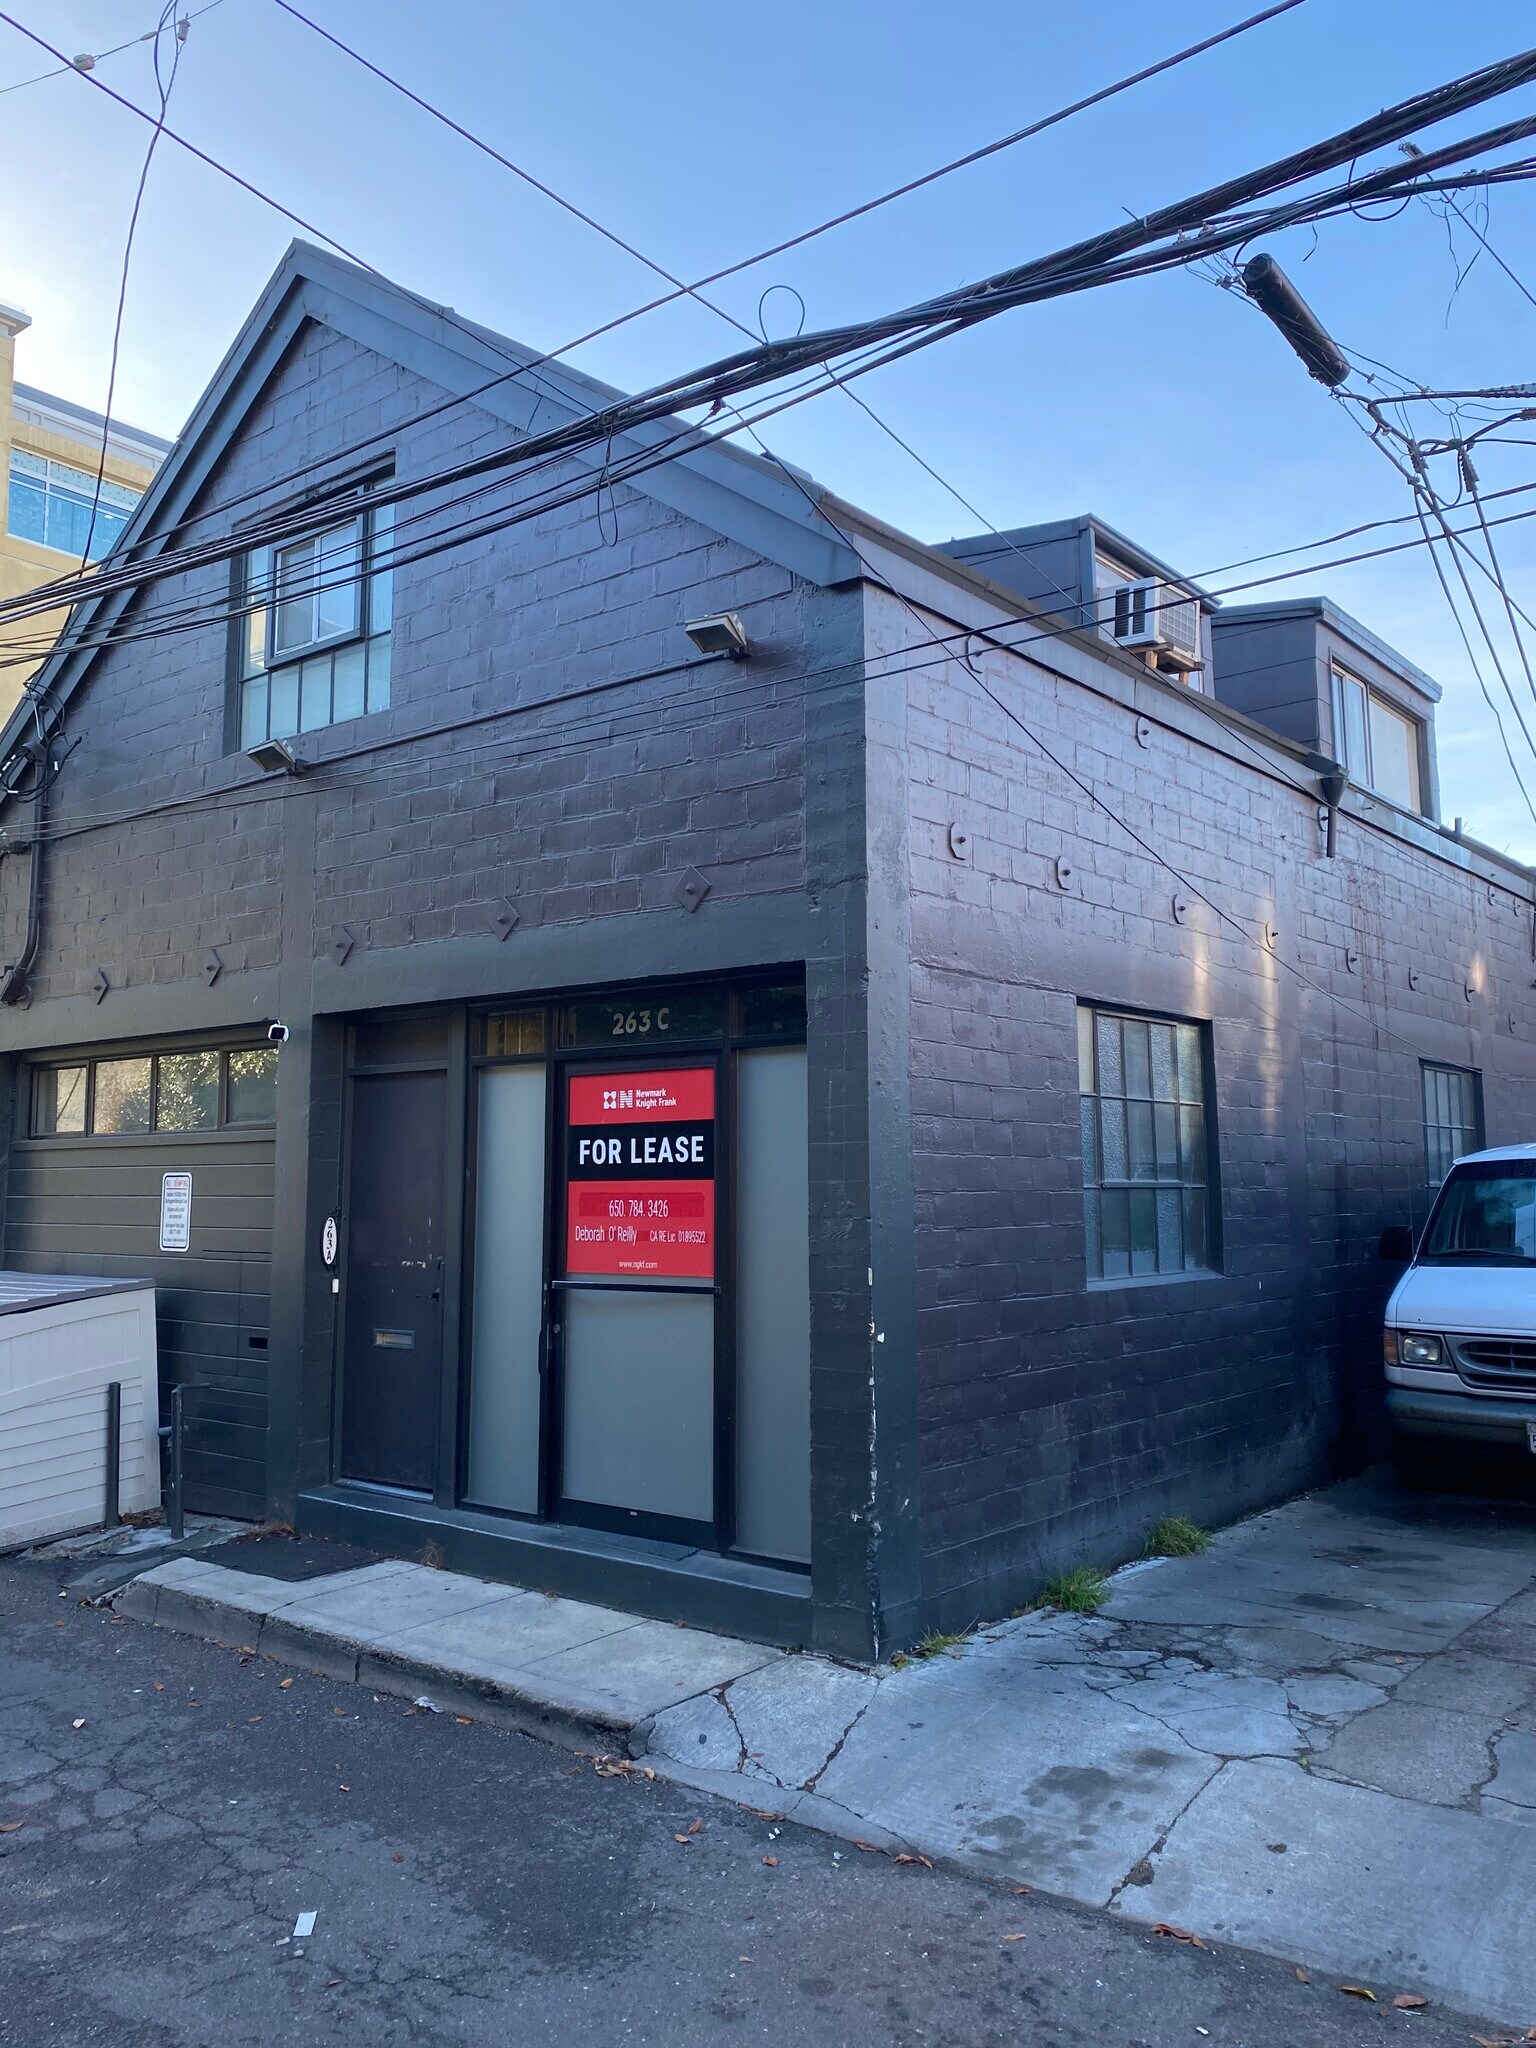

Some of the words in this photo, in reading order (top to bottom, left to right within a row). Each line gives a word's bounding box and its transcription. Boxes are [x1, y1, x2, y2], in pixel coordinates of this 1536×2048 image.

[612, 1010, 651, 1035] 263
[657, 1007, 670, 1031] C
[635, 1088, 667, 1098] Newmark
[635, 1099, 657, 1110] Knight
[658, 1097, 677, 1107] Frank
[579, 1138, 622, 1165] FOR
[630, 1136, 704, 1164] LEASE
[609, 1199, 626, 1217] 650.
[628, 1199, 646, 1217] 784.
[647, 1199, 669, 1217] 3426
[575, 1225, 605, 1242] Deborah
[619, 1260, 658, 1271] www.ngkf.com
